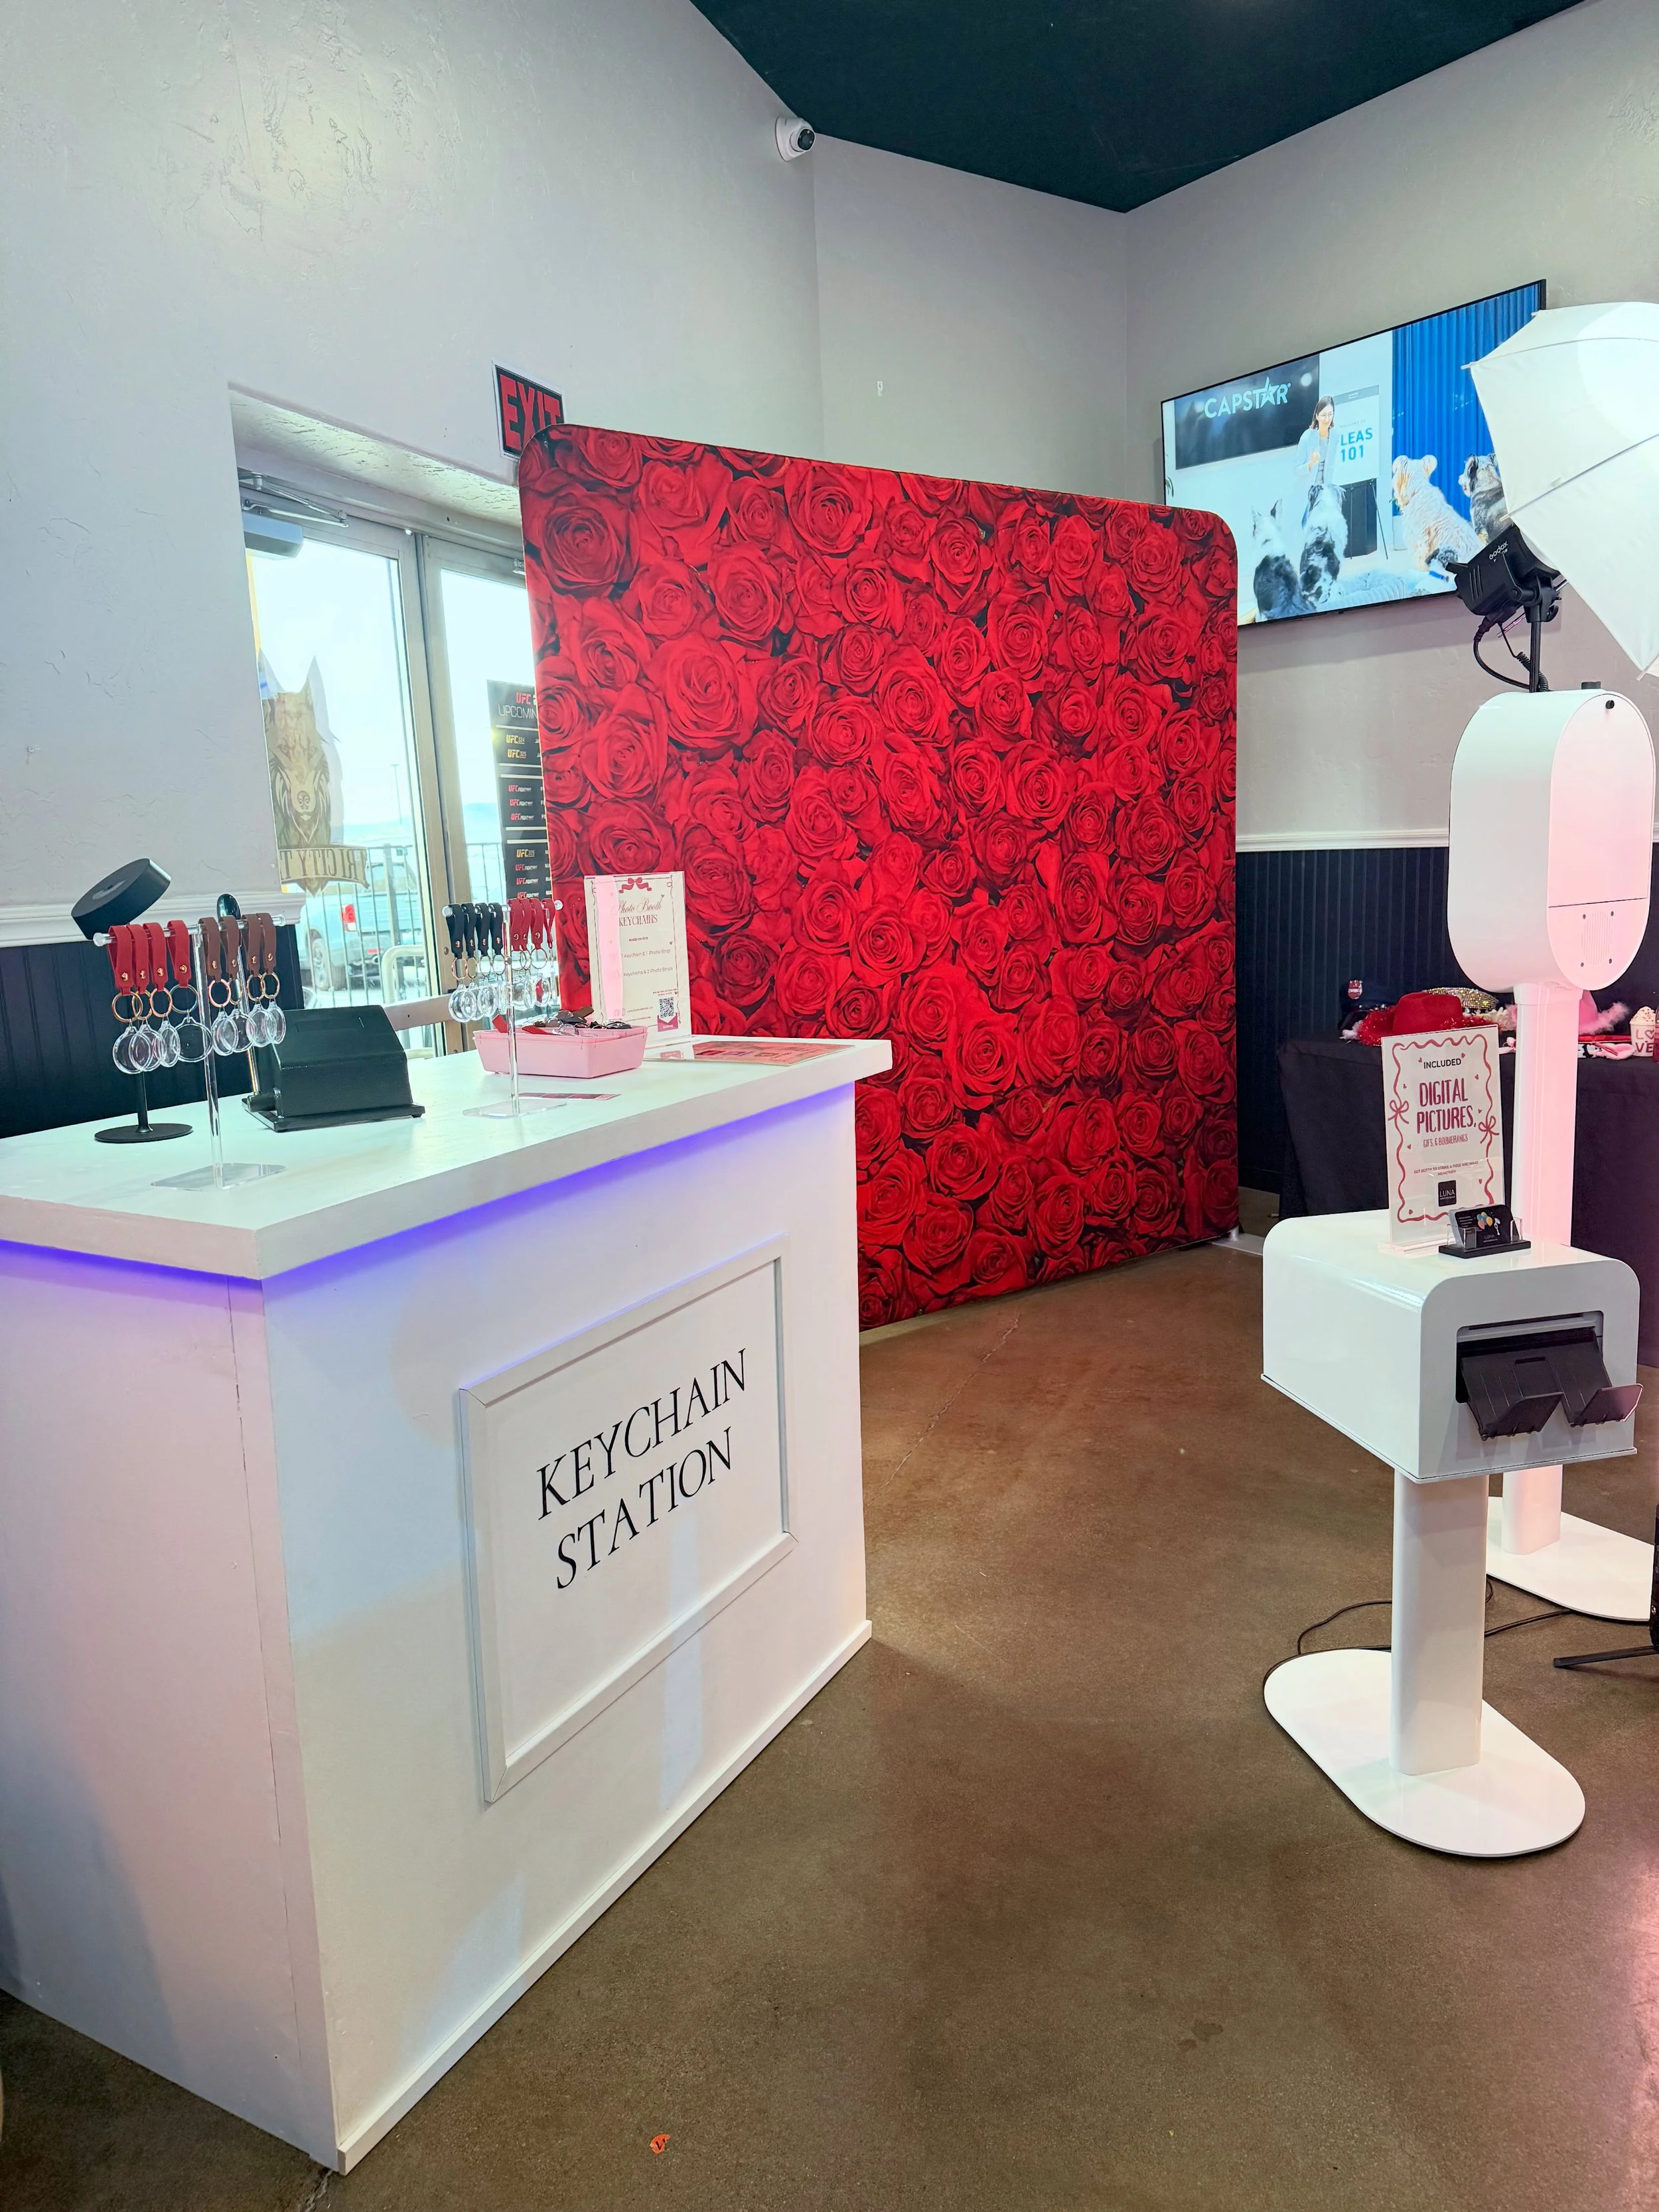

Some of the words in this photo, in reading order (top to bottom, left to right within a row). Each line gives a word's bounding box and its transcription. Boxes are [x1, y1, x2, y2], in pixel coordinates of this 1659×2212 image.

[500, 374, 561, 451] EXIT
[1340, 445, 1364, 463] 101
[1488, 540, 1508, 560] Godox
[516, 692, 532, 705] UFC
[1423, 1058, 1462, 1069] INCLUDED
[1419, 1078, 1469, 1107] DIGITAL
[1417, 1105, 1477, 1134] PICTURES,
[1439, 1134, 1468, 1146] BOOMERANGS
[1439, 1189, 1455, 1197] LUNA
[537, 1348, 746, 1520] KEYCHAIN
[557, 1426, 731, 1589] STATION
